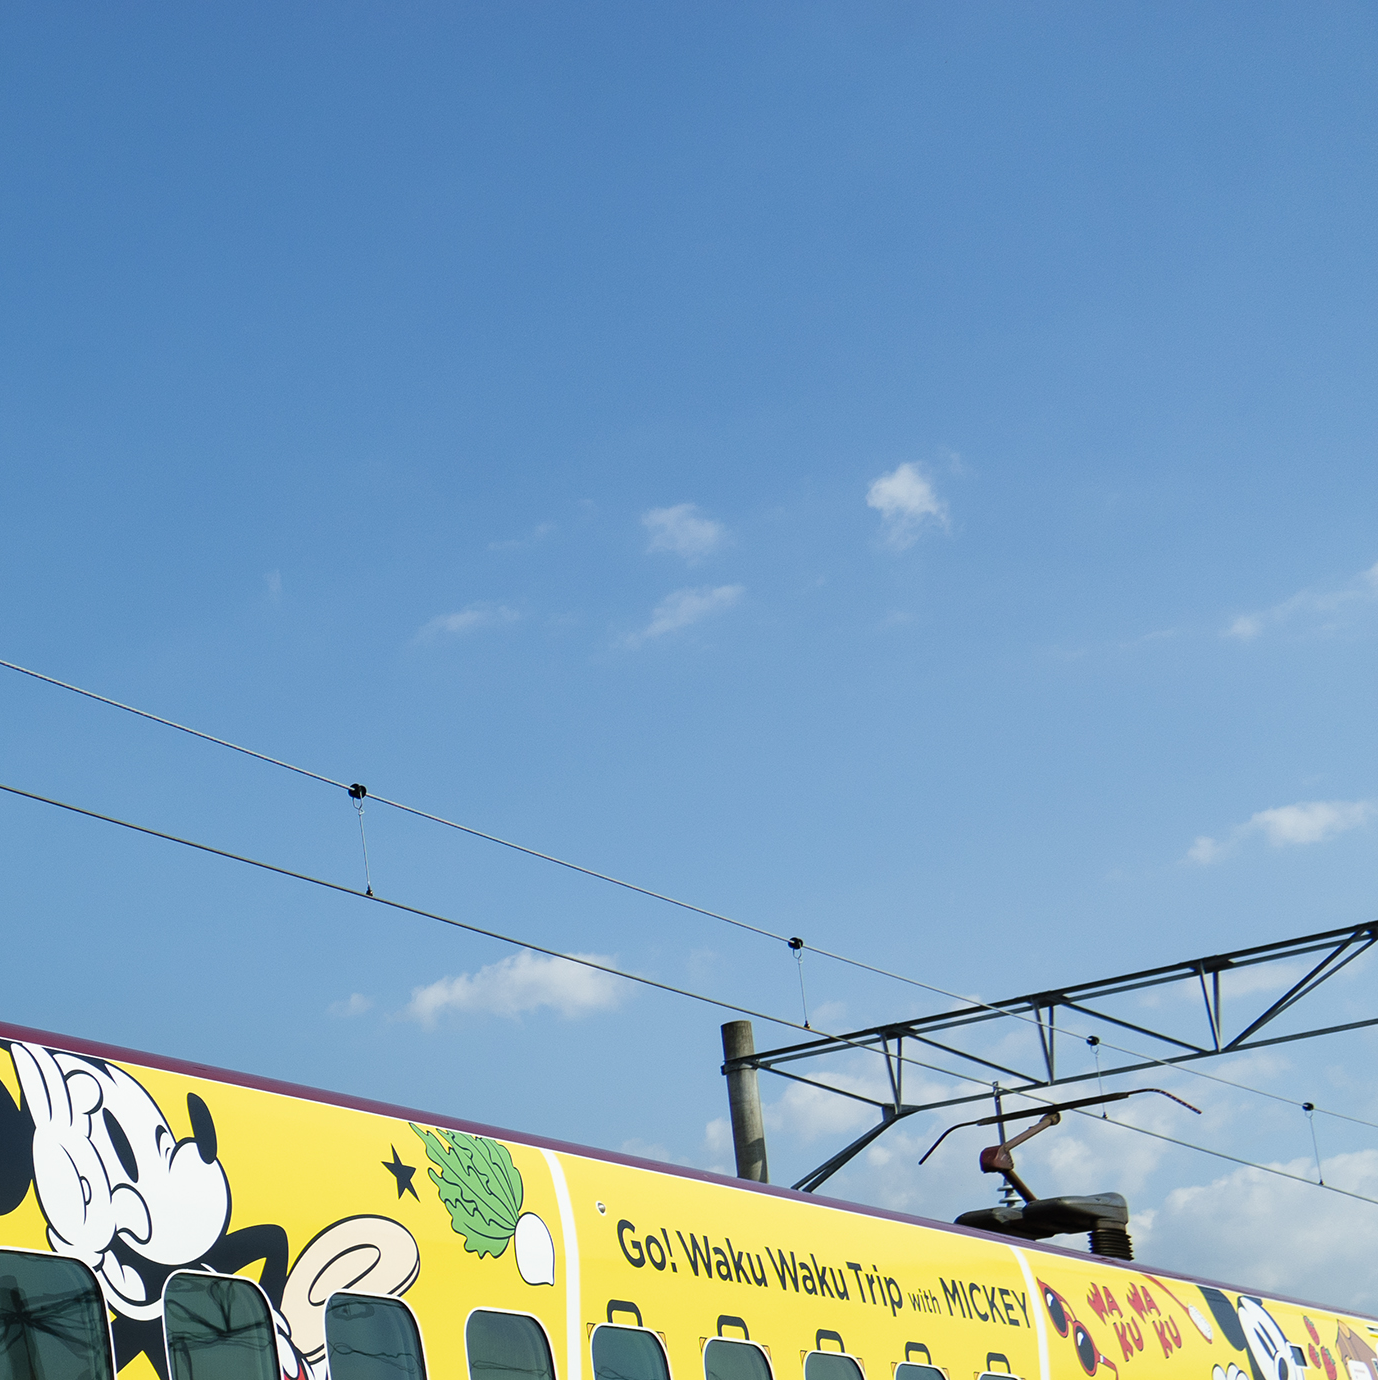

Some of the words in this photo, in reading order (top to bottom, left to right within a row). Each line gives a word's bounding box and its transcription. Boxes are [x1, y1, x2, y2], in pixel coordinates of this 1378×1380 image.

[616, 1219, 679, 1274] Go!
[675, 1230, 769, 1289] Waku
[764, 1246, 850, 1302] Waku
[846, 1261, 904, 1318] Trip
[907, 1287, 942, 1316] with
[938, 1276, 1032, 1330] MICKEY
[1087, 1282, 1123, 1326] WA
[1126, 1282, 1161, 1324] WA
[1113, 1316, 1144, 1362] KU
[1152, 1315, 1182, 1359] KU
